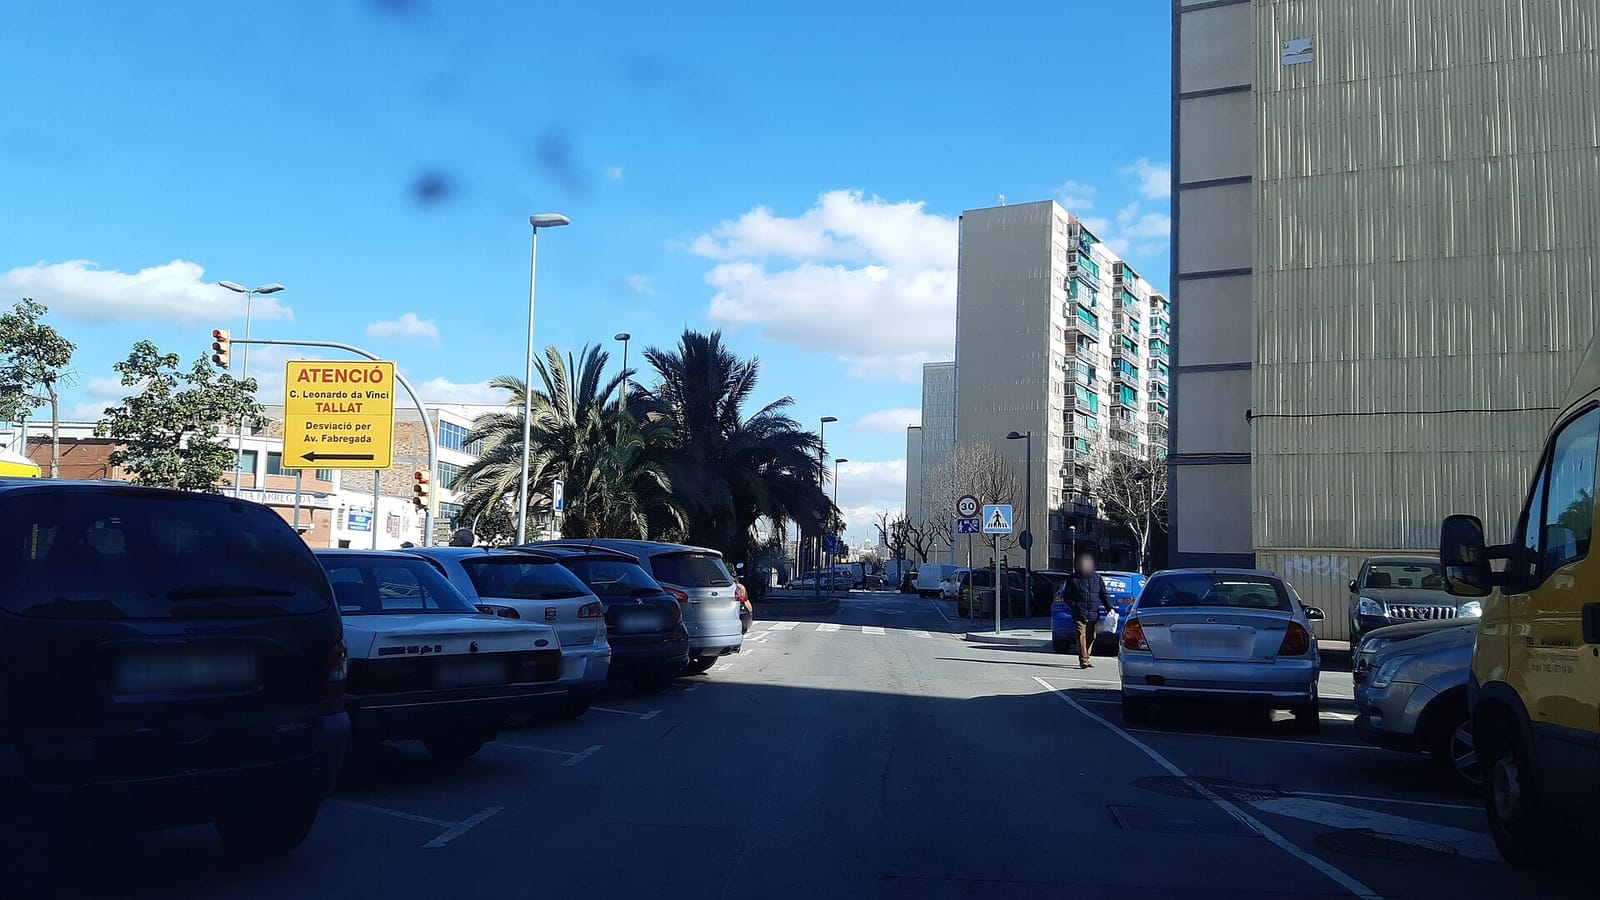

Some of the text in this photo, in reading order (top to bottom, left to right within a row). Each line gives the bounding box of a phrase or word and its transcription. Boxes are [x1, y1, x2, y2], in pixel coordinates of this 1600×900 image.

[297, 366, 383, 383] ATENCIÓ
[289, 390, 389, 399] C. Leonardo da Vinci
[315, 402, 363, 413] TALLAT
[305, 422, 371, 432] Desviació per
[304, 435, 372, 444] Av. Fabregada
[961, 503, 975, 511] 30
